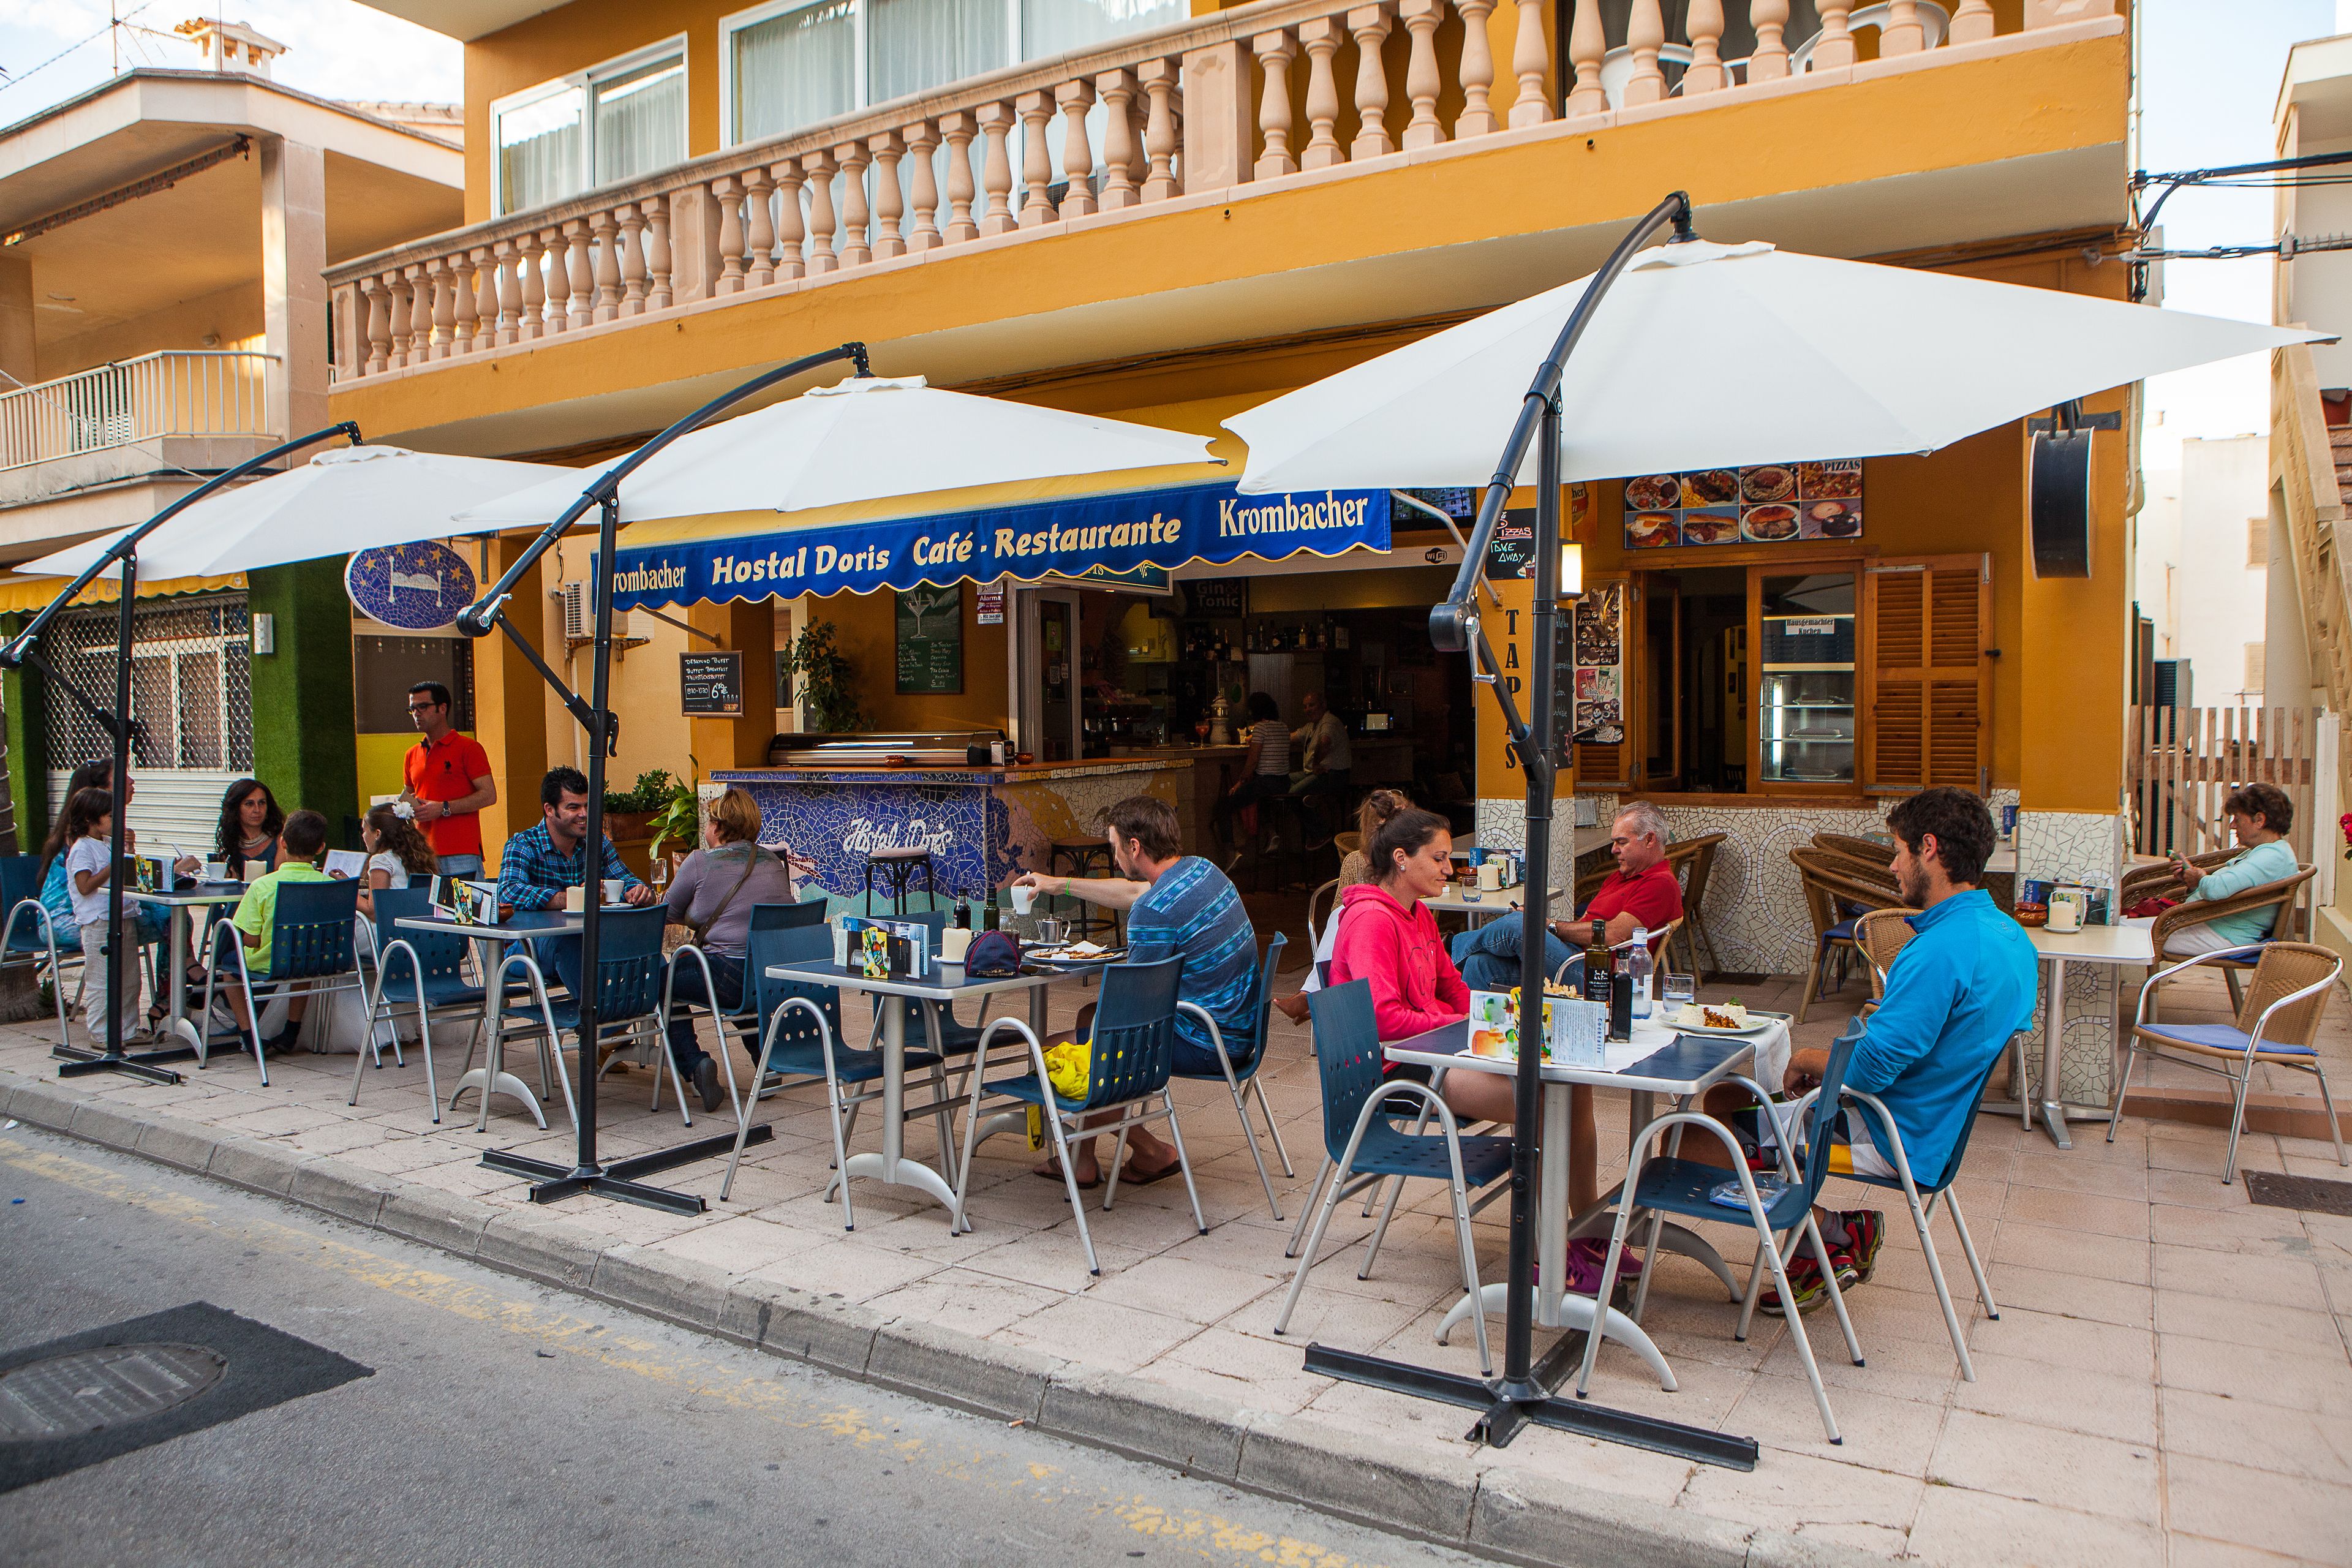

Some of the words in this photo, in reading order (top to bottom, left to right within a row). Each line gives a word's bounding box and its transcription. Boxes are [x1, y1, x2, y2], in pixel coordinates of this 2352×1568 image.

[1823, 459, 1861, 471] PIZZAS
[1219, 491, 1368, 537] Krombacher
[1491, 541, 1516, 552] TAKE
[613, 559, 686, 593] rombacher
[712, 547, 806, 586] Hostal
[815, 545, 889, 575] Doris
[913, 532, 973, 566] Café
[995, 513, 1181, 558] Restaurante
[1498, 553, 1525, 563] AWAY
[1197, 594, 1238, 607] Tonic
[1787, 619, 1833, 627] Hausgemachter
[843, 817, 899, 854] Hostal
[905, 819, 953, 856] Doris
